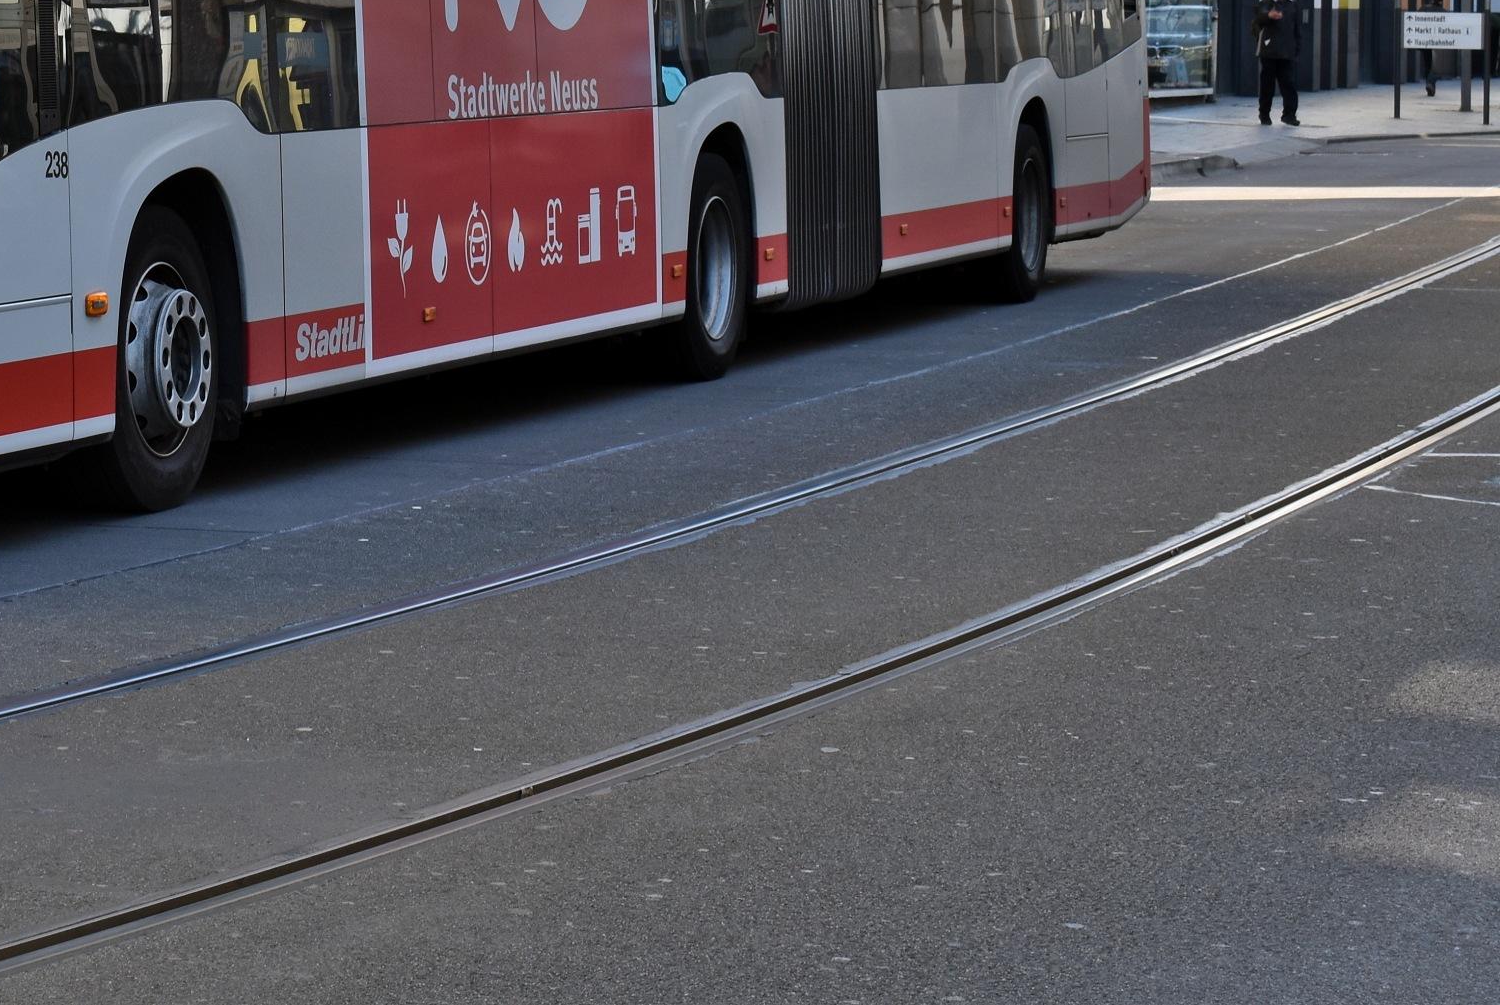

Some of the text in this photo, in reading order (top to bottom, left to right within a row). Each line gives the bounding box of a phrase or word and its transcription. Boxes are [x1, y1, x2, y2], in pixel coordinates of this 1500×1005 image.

[1414, 27, 1432, 35] Markt
[447, 70, 599, 120] Stadtwerke Neuss
[45, 150, 69, 179] 238
[296, 314, 364, 362] StadtLi
